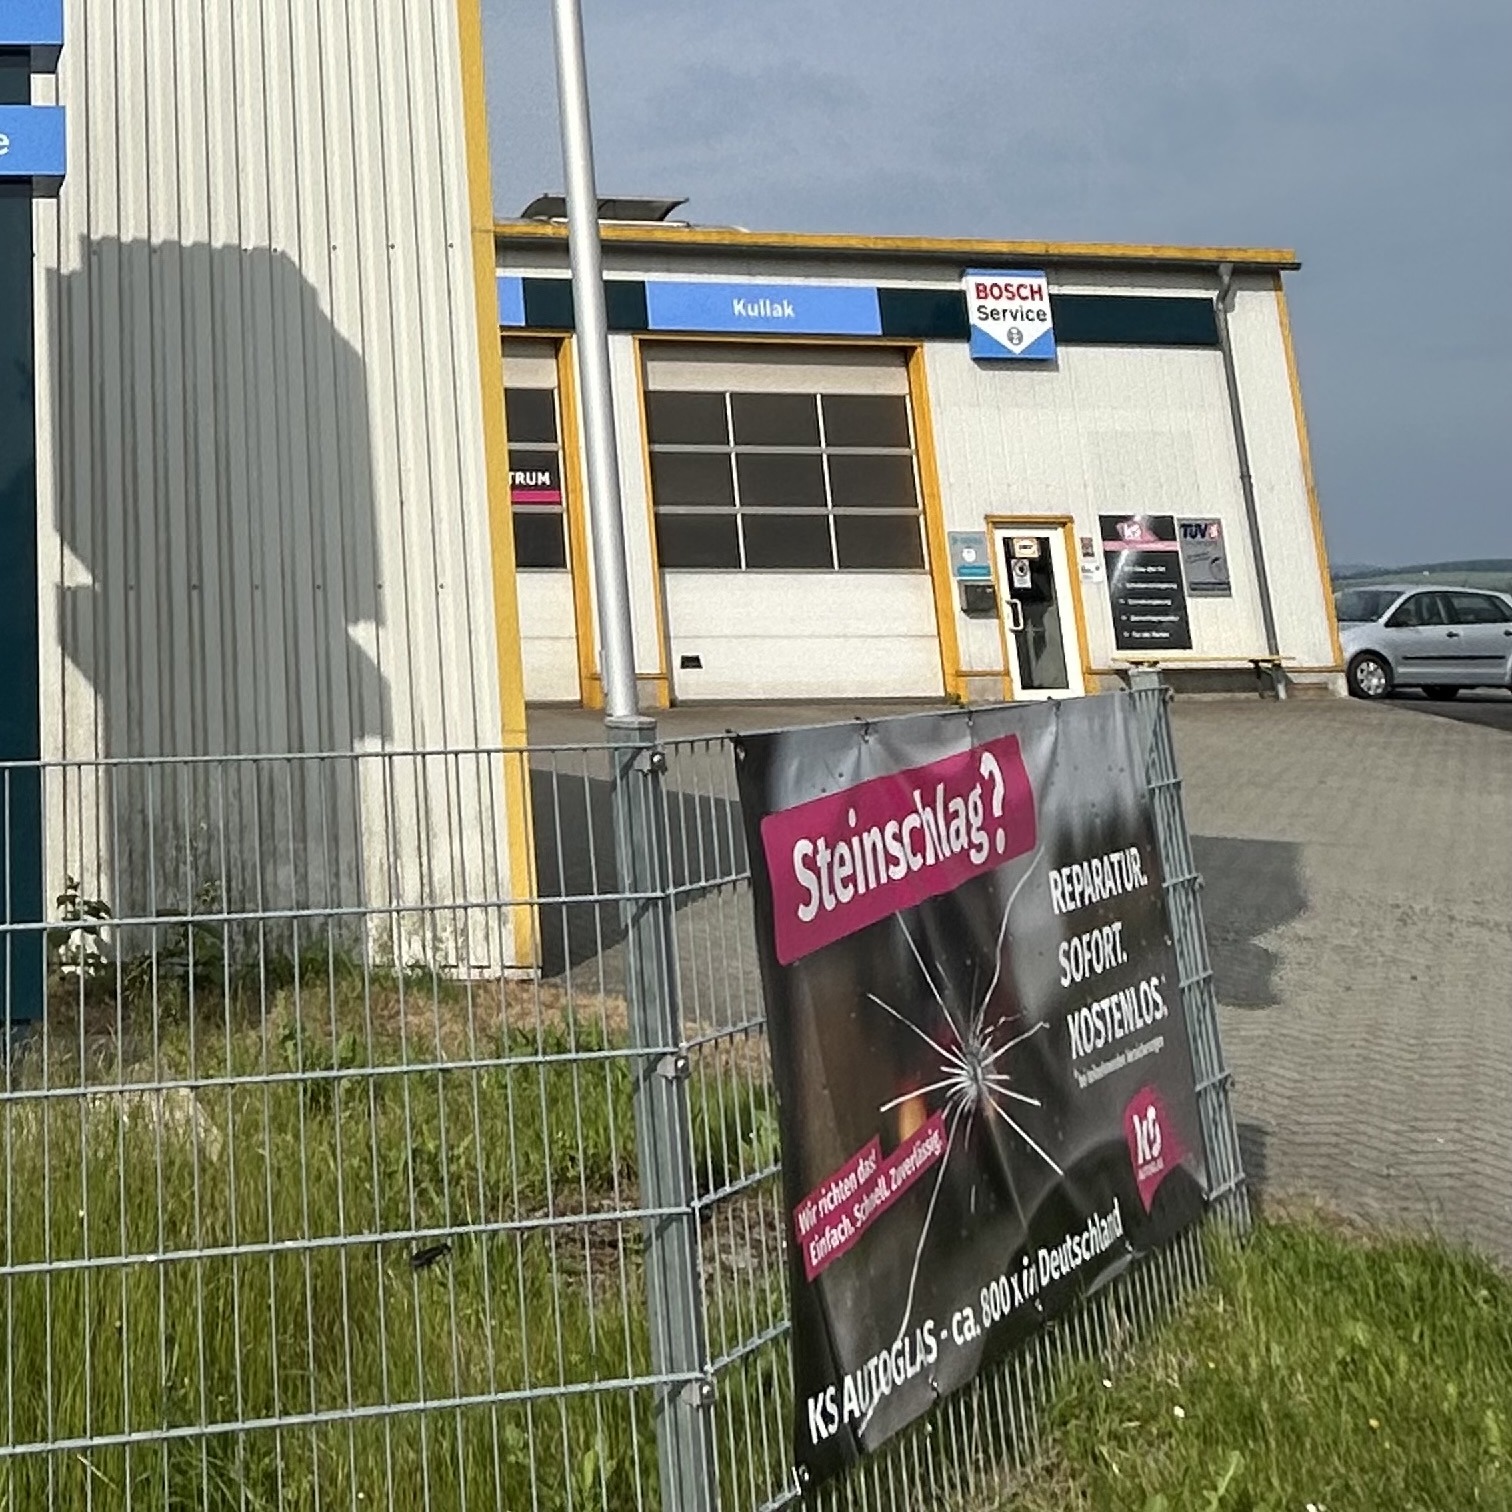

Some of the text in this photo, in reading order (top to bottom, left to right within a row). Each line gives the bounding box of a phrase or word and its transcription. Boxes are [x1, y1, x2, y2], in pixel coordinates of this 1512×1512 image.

[732, 298, 796, 319] Kullak
[974, 281, 1044, 302] BOSCH
[976, 304, 1048, 322] Service
[792, 751, 1006, 923] Steinschlag?
[1048, 846, 1149, 915] REPARATUR.
[1059, 920, 1128, 987] SOFORT.
[798, 1200, 818, 1236] Wir
[818, 1172, 858, 1218] richten
[809, 1214, 856, 1267] Einfach.
[852, 1174, 891, 1228] Schnell.
[808, 1386, 839, 1445] KS
[842, 1318, 938, 1424] AUTOGLAS
[952, 1306, 981, 1346] ca.
[980, 1275, 1012, 1328] 800
[1011, 1271, 1024, 1308] x
[1021, 1255, 1040, 1299] in
[1038, 1196, 1124, 1287] Deutschland
